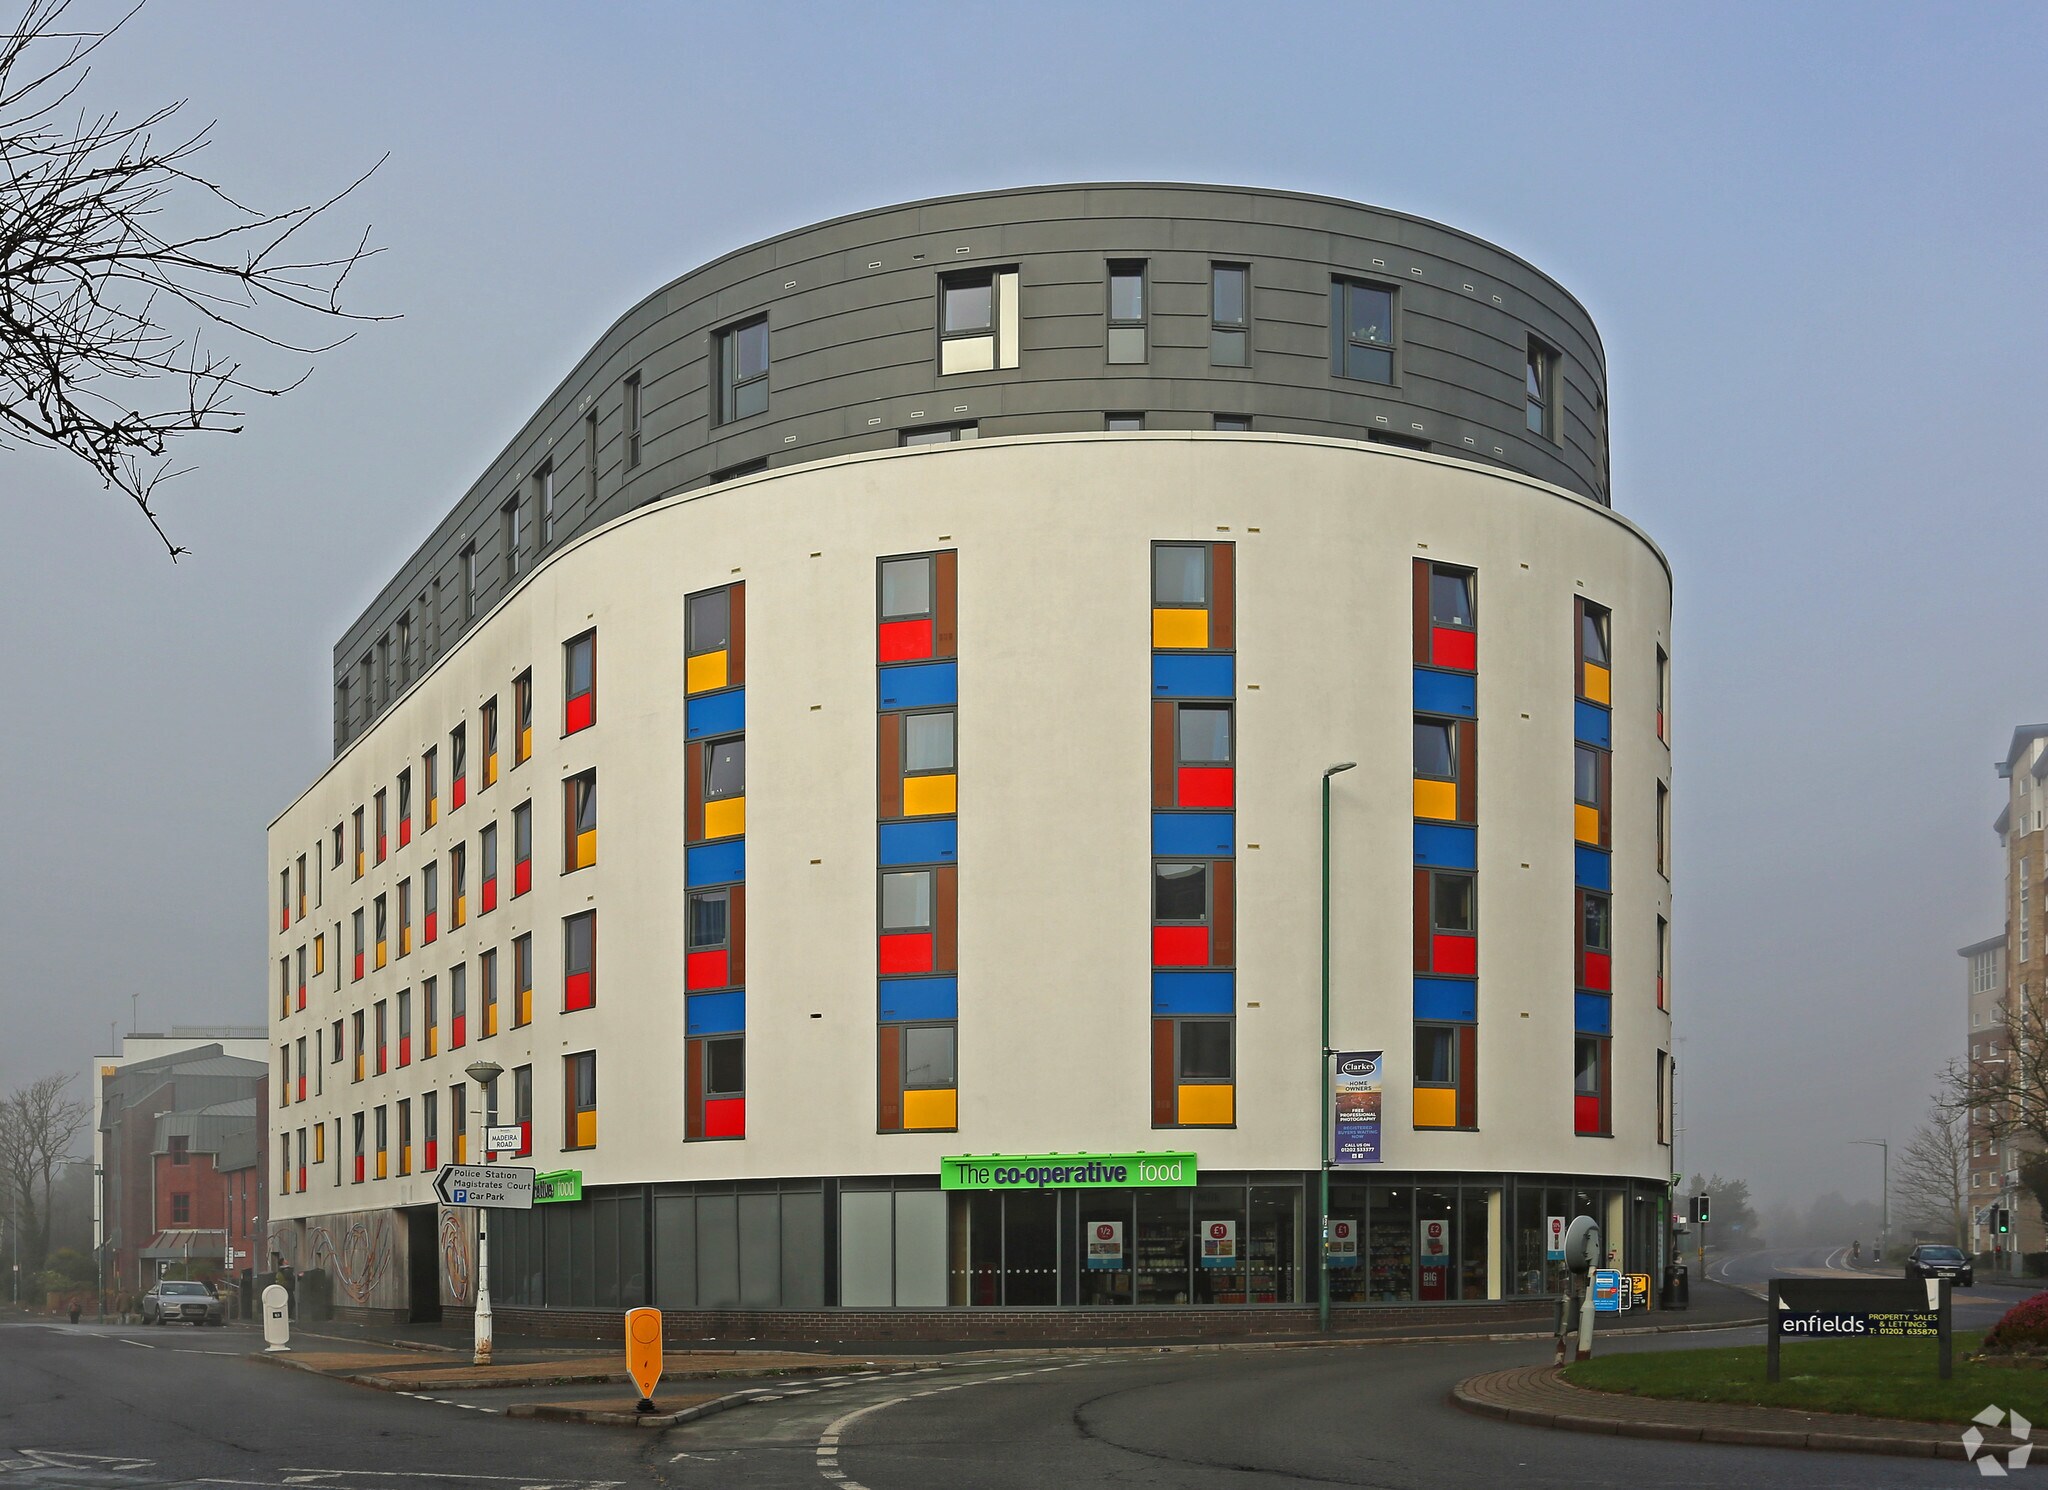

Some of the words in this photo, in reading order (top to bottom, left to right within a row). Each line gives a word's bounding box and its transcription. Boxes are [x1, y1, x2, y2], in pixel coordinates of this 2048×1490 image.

[485, 1171, 517, 1179] Station
[956, 1163, 989, 1184] The
[994, 1161, 1127, 1187] co-operative
[1138, 1160, 1182, 1182] food
[454, 1180, 503, 1189] Magistrates
[507, 1182, 531, 1190] Court
[557, 1177, 575, 1196] food
[486, 1193, 504, 1201] Park
[1100, 1227, 1110, 1235] 1/2
[1213, 1226, 1224, 1235] £1
[1338, 1225, 1347, 1234] £1
[1430, 1225, 1440, 1233] £2
[1424, 1272, 1437, 1281] BIG
[1783, 1315, 1864, 1332] enfields
